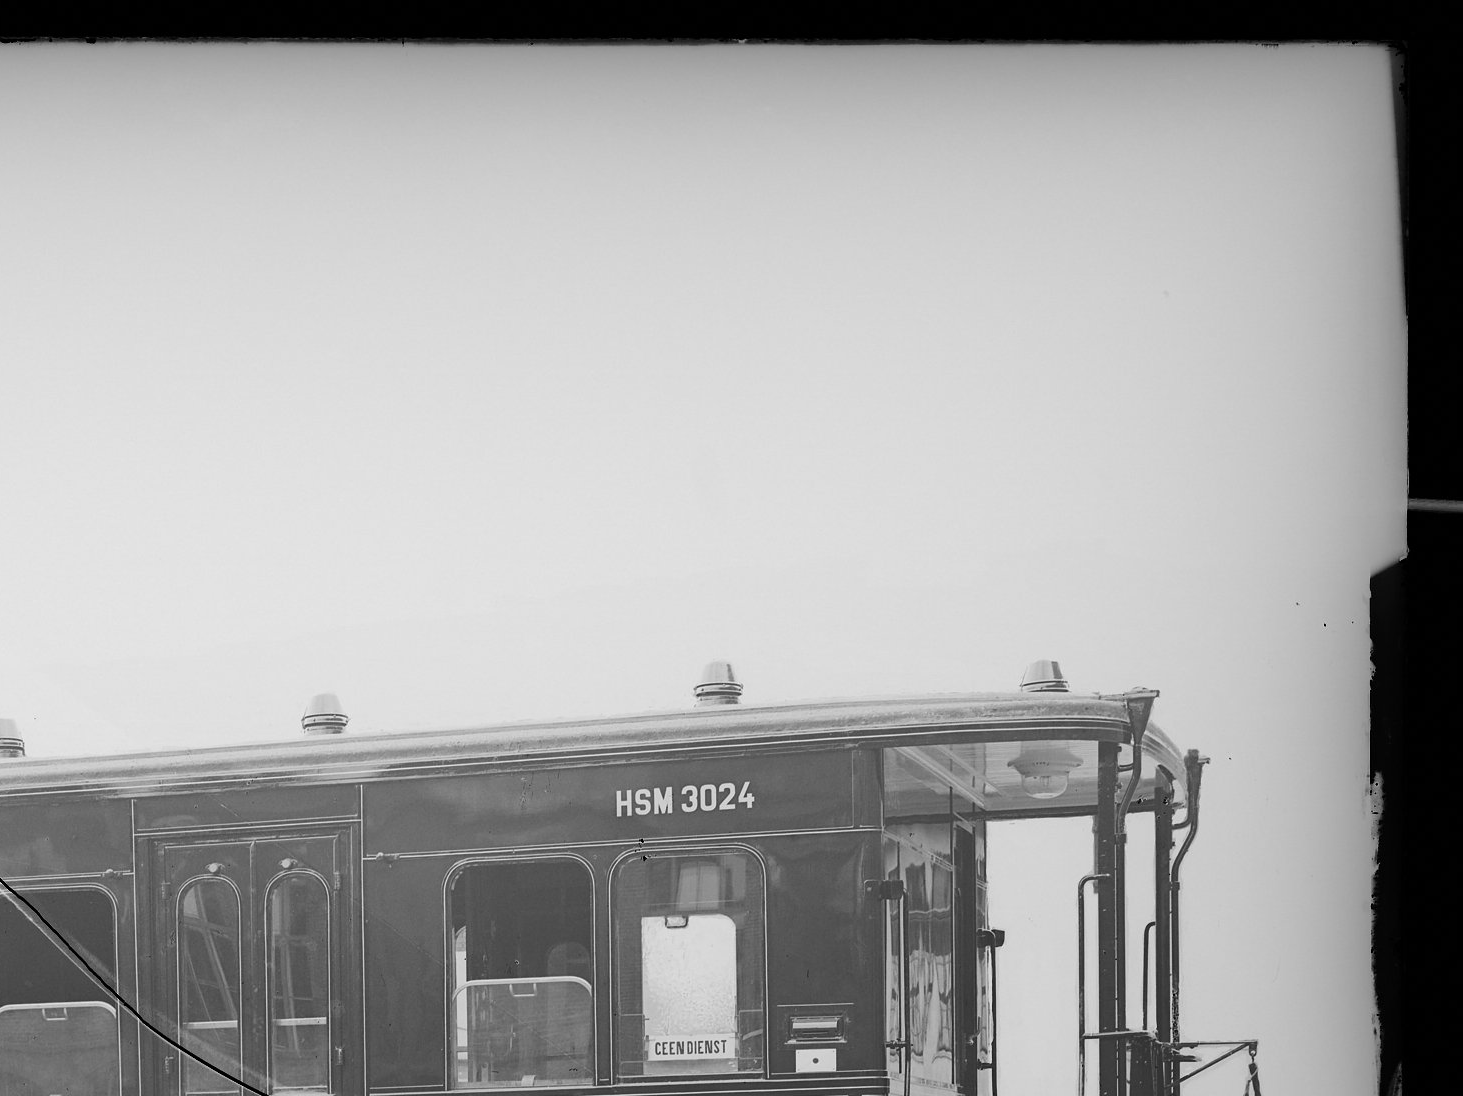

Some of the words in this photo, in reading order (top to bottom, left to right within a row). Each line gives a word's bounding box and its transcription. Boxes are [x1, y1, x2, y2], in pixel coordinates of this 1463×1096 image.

[616, 786, 673, 817] HSM
[681, 781, 755, 813] 3024
[687, 1040, 727, 1054] DIENST
